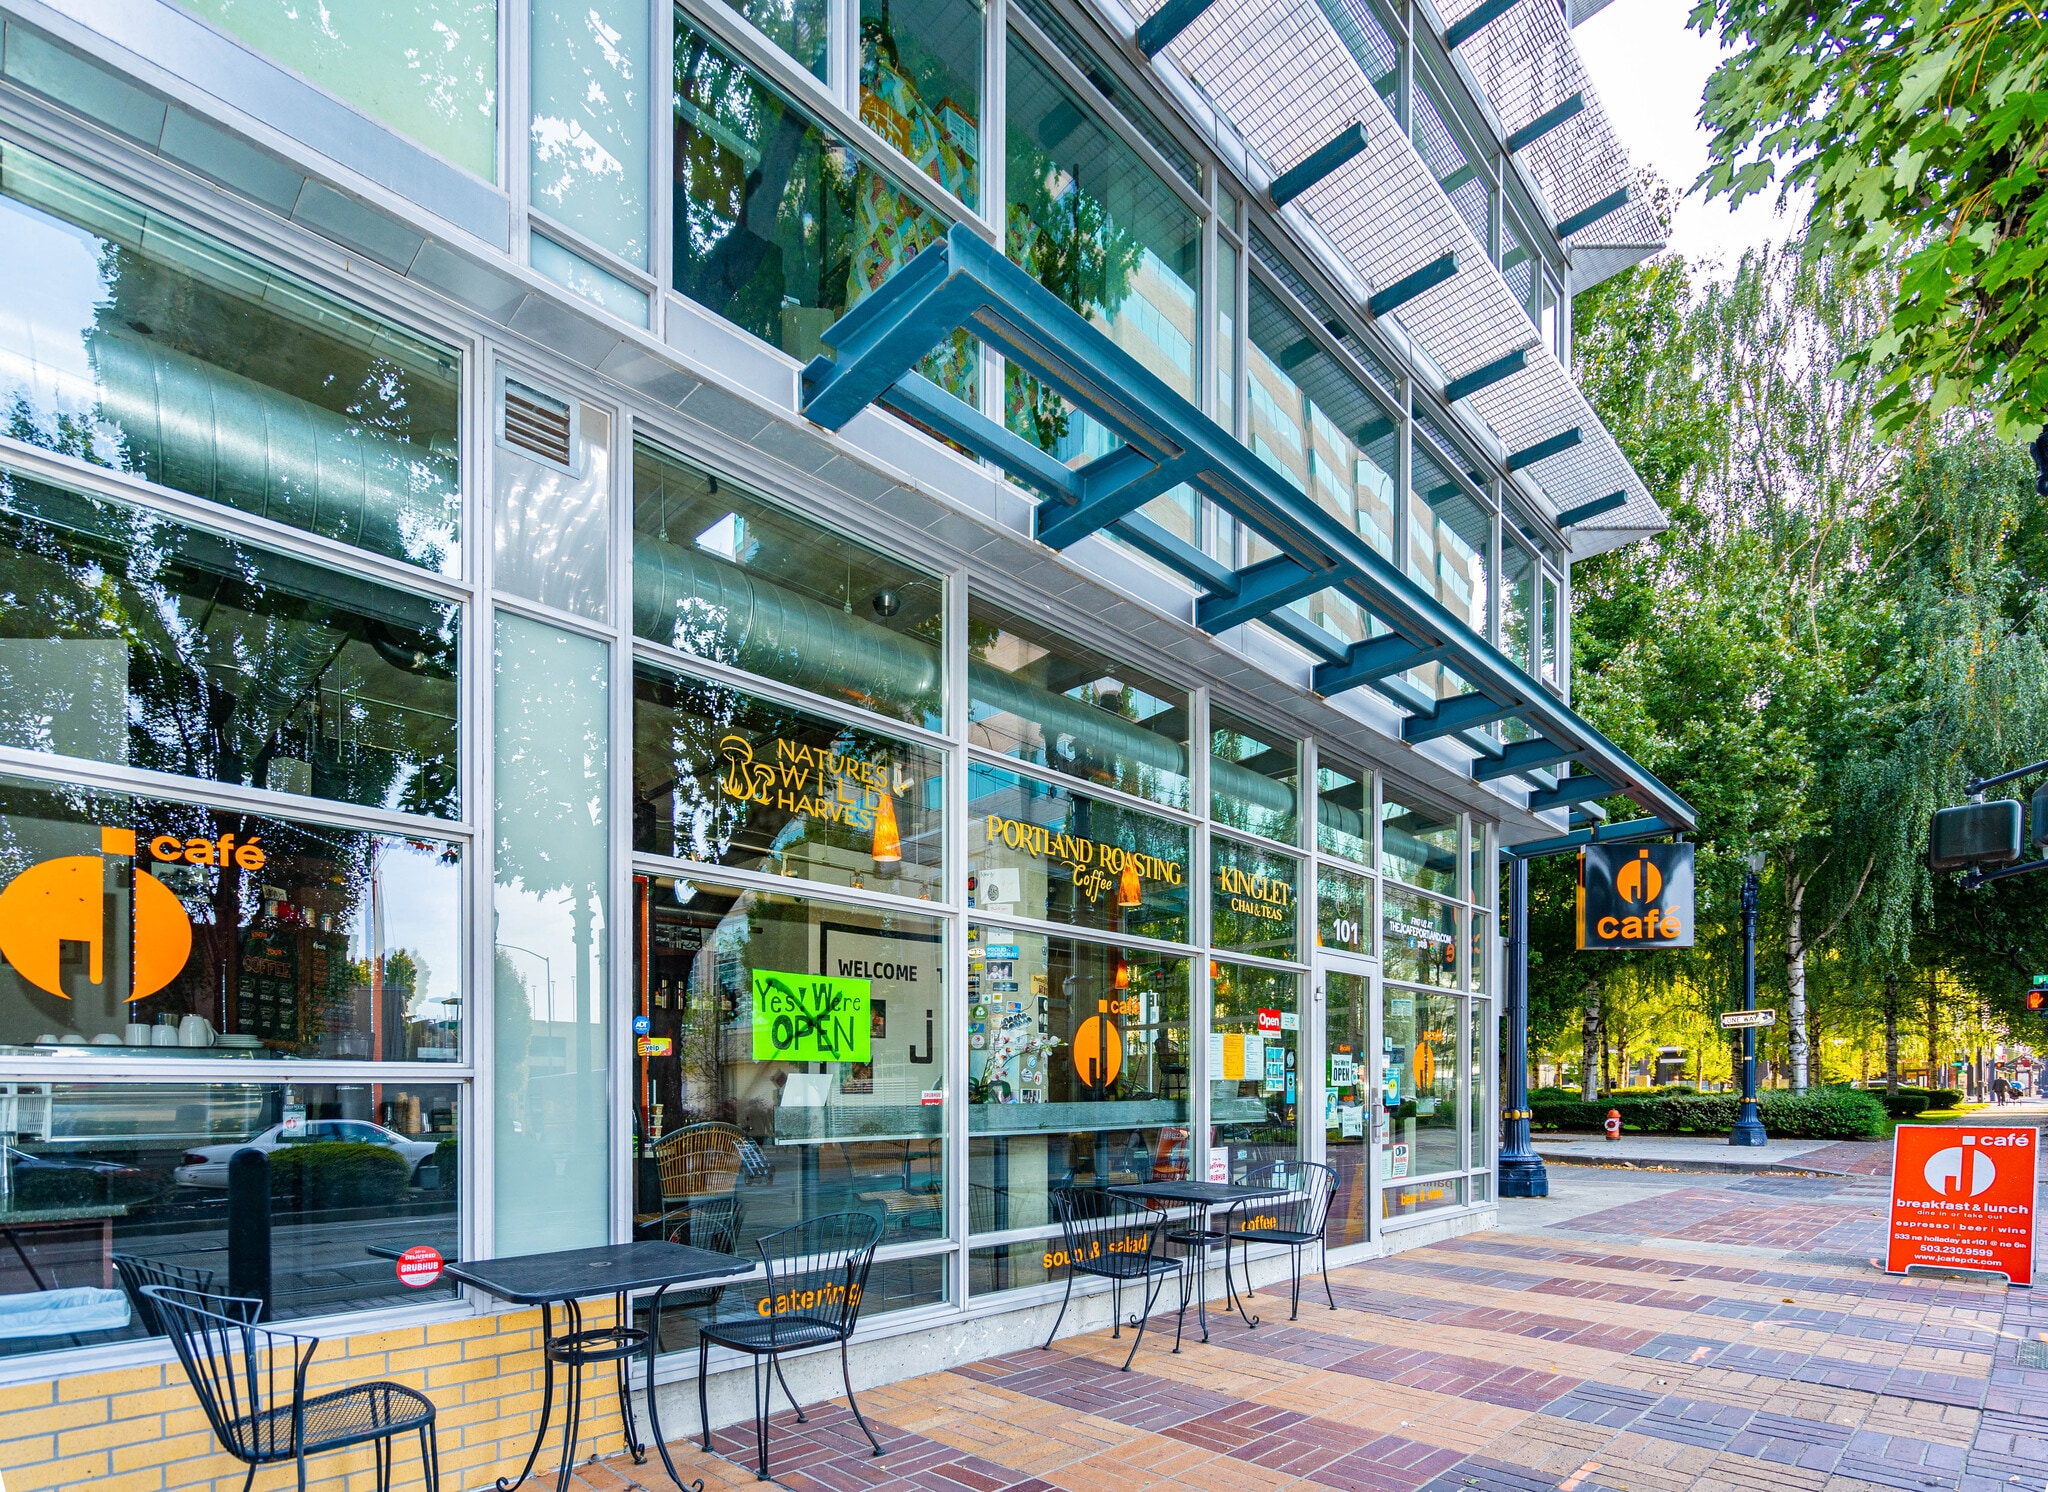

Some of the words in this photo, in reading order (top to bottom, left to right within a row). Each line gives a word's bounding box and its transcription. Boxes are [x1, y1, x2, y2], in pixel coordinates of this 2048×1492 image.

[778, 738, 888, 788] NATURES
[779, 761, 886, 811] WILD
[150, 833, 266, 871] café
[987, 814, 1093, 864] PORTLAND
[1100, 844, 1181, 885] ROASTING
[1060, 860, 1112, 903] Coffee
[1221, 865, 1290, 906] KINGLET
[1231, 898, 1254, 914] CHAI
[1254, 905, 1261, 917] &
[1261, 905, 1282, 921] TEAS
[1333, 918, 1358, 944] 101
[1597, 905, 1682, 939] café
[242, 955, 291, 979] COFFEE
[838, 959, 917, 982] WELCOME
[1110, 995, 1141, 1015] café
[1259, 1012, 1280, 1028] Open
[772, 1014, 854, 1052] OPEN
[1333, 1068, 1349, 1081] OPEN
[1980, 1133, 2029, 1147] café
[1896, 1198, 1970, 1211] breakfast
[1972, 1203, 1981, 1212] &
[1984, 1203, 2029, 1214] lunch
[1241, 1215, 1277, 1232] coffee
[1920, 1244, 1993, 1257] 503.230.9599
[1924, 1235, 1960, 1244] holladay
[401, 1262, 439, 1272] GRUBHUB
[1914, 1254, 2002, 1266] www.jcafepdx.com
